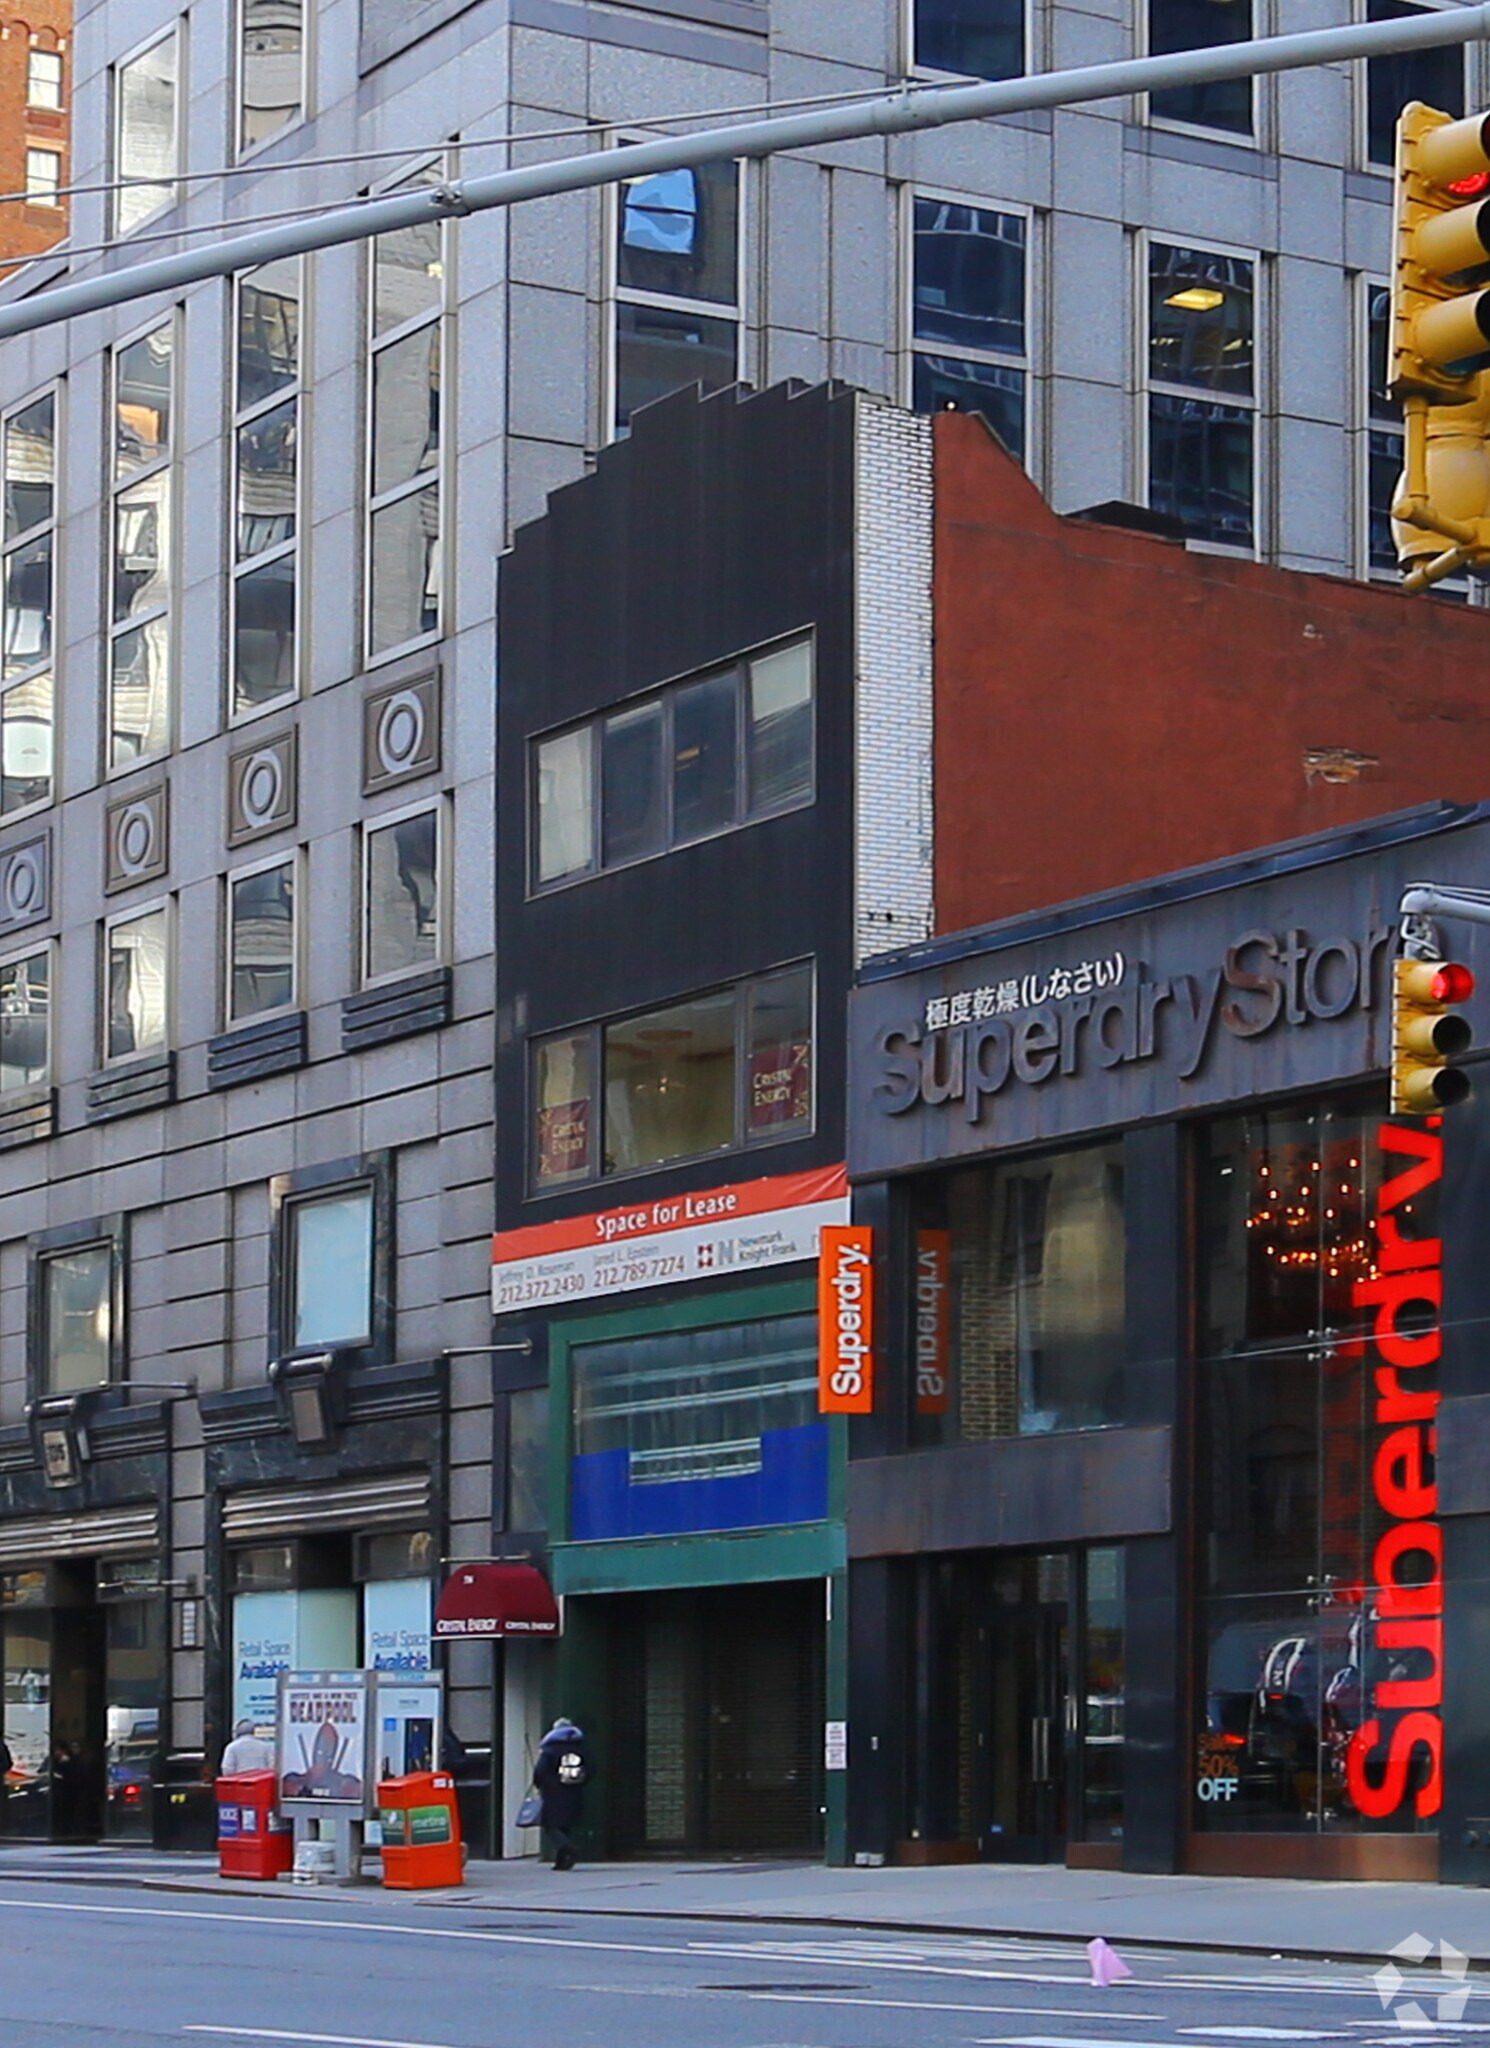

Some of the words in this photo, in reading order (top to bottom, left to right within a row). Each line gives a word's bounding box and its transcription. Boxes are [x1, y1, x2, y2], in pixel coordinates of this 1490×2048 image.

[925, 951, 1124, 1031] 極度乾燥(しなさい)
[595, 1211, 647, 1240] Space
[652, 1203, 678, 1226] for
[685, 1194, 736, 1219] Lease
[771, 1241, 798, 1257] Frank
[593, 1254, 686, 1289] 212.789.7274
[498, 1273, 586, 1306] 212.372.2430
[831, 1243, 871, 1396] Superdry.
[1197, 1777, 1239, 1801] OFF
